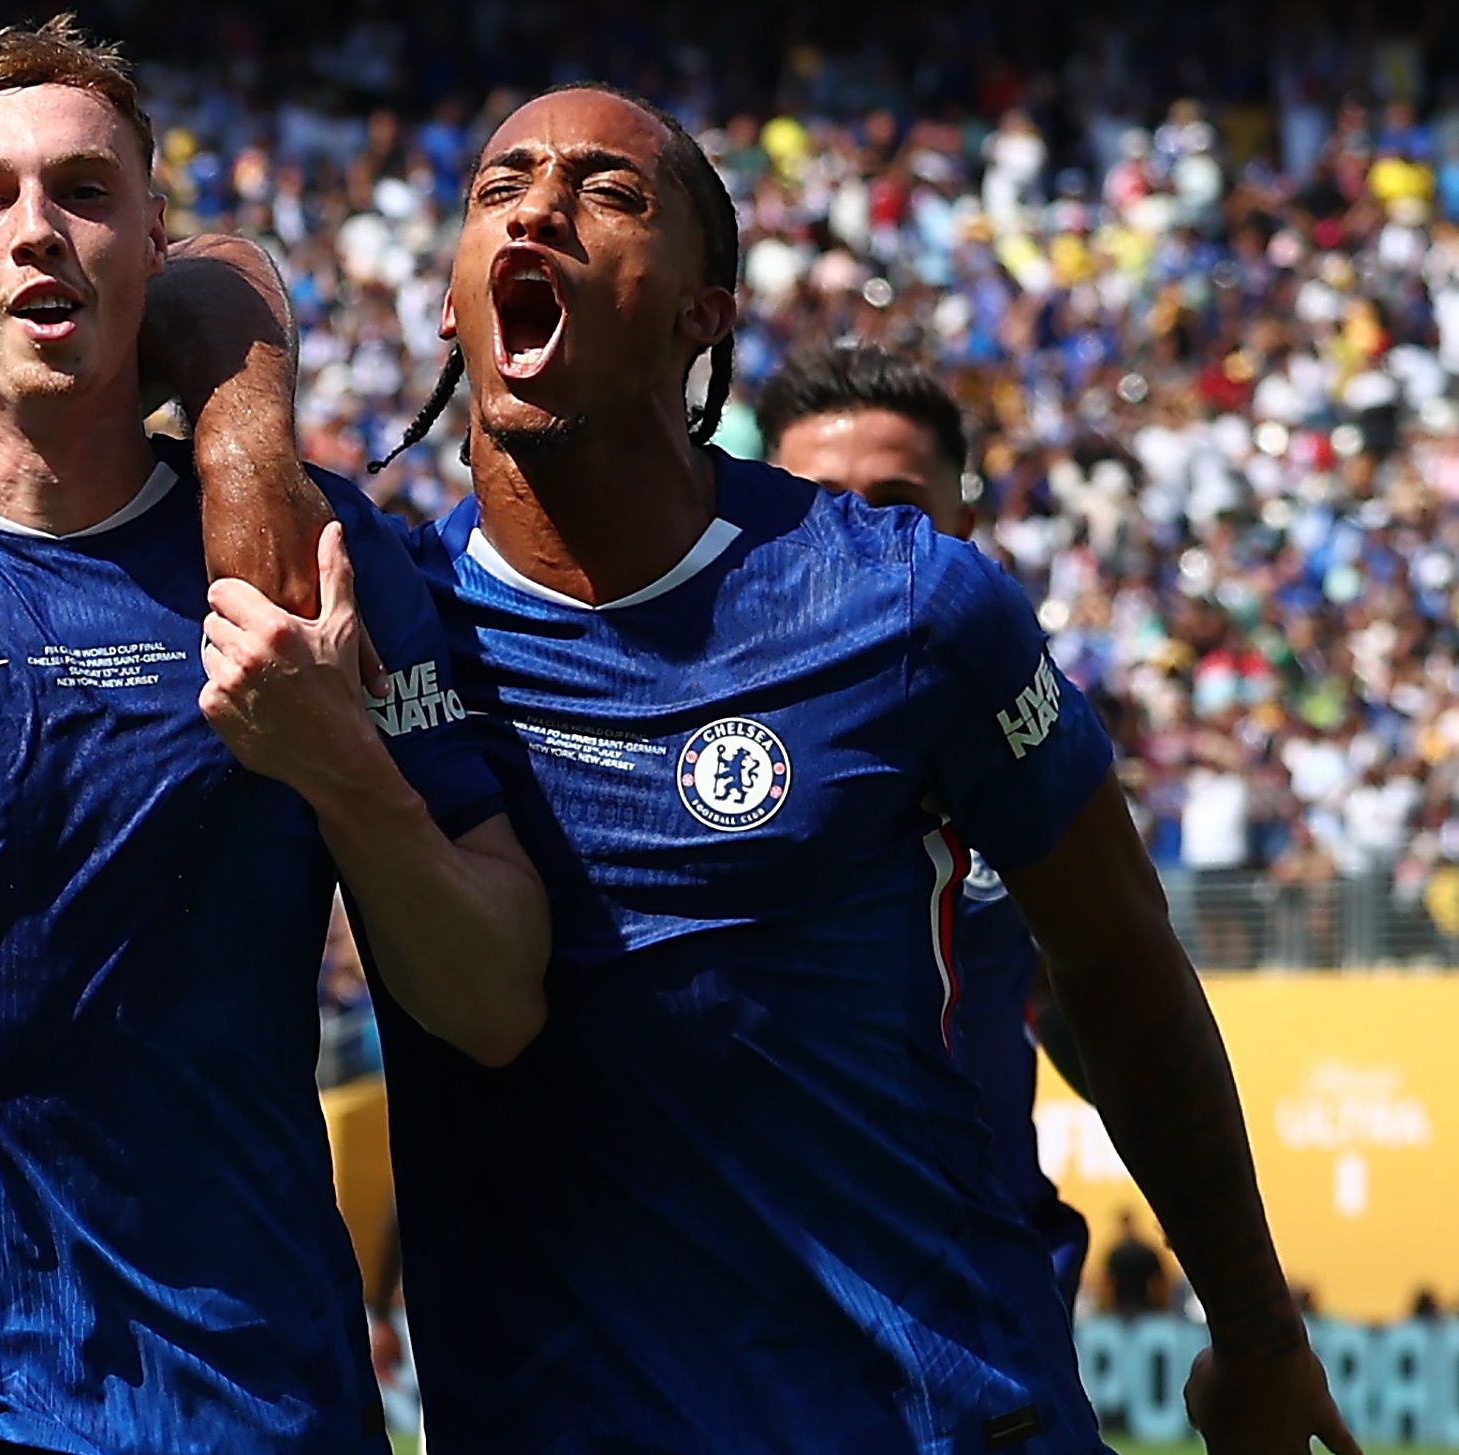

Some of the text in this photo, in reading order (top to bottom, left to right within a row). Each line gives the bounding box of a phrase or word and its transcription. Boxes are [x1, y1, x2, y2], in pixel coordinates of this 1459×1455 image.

[82, 646, 117, 658] WORLD
[118, 644, 138, 655] CUP
[139, 641, 166, 652] FINAL
[86, 657, 113, 667] PARIS
[113, 651, 187, 666] SAINT-GERMAIN
[119, 666, 141, 676] JULY
[101, 678, 124, 688] NEW
[124, 674, 159, 687] JERSEY
[506, 719, 547, 735] HELSEA
[571, 733, 597, 746] PARIS
[598, 738, 667, 755] SAINT-GERMAIN
[702, 721, 774, 752] CHELSEA
[545, 736, 582, 750] SUNDAY
[598, 748, 622, 759] JULY
[578, 752, 601, 764] NEW
[600, 758, 636, 771] JERSEY
[691, 799, 766, 825] FOOTBALL CLUB
